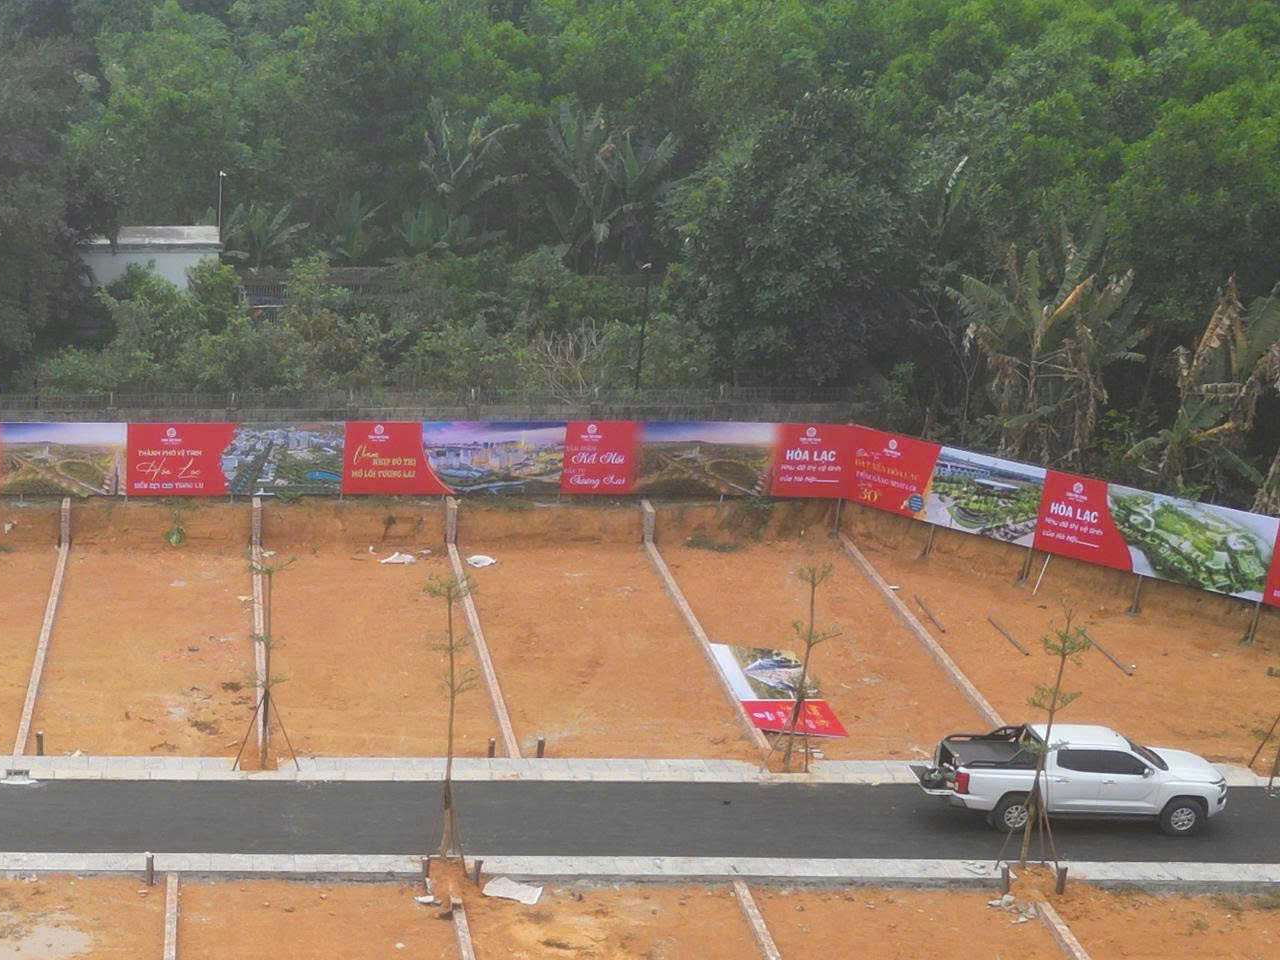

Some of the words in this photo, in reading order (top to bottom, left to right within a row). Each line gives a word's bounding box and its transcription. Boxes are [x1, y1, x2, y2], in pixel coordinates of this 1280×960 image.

[786, 448, 809, 461] HÒA
[813, 450, 836, 463] LẠC
[1050, 501, 1073, 518] HÒA
[1076, 508, 1099, 524] LẠC
